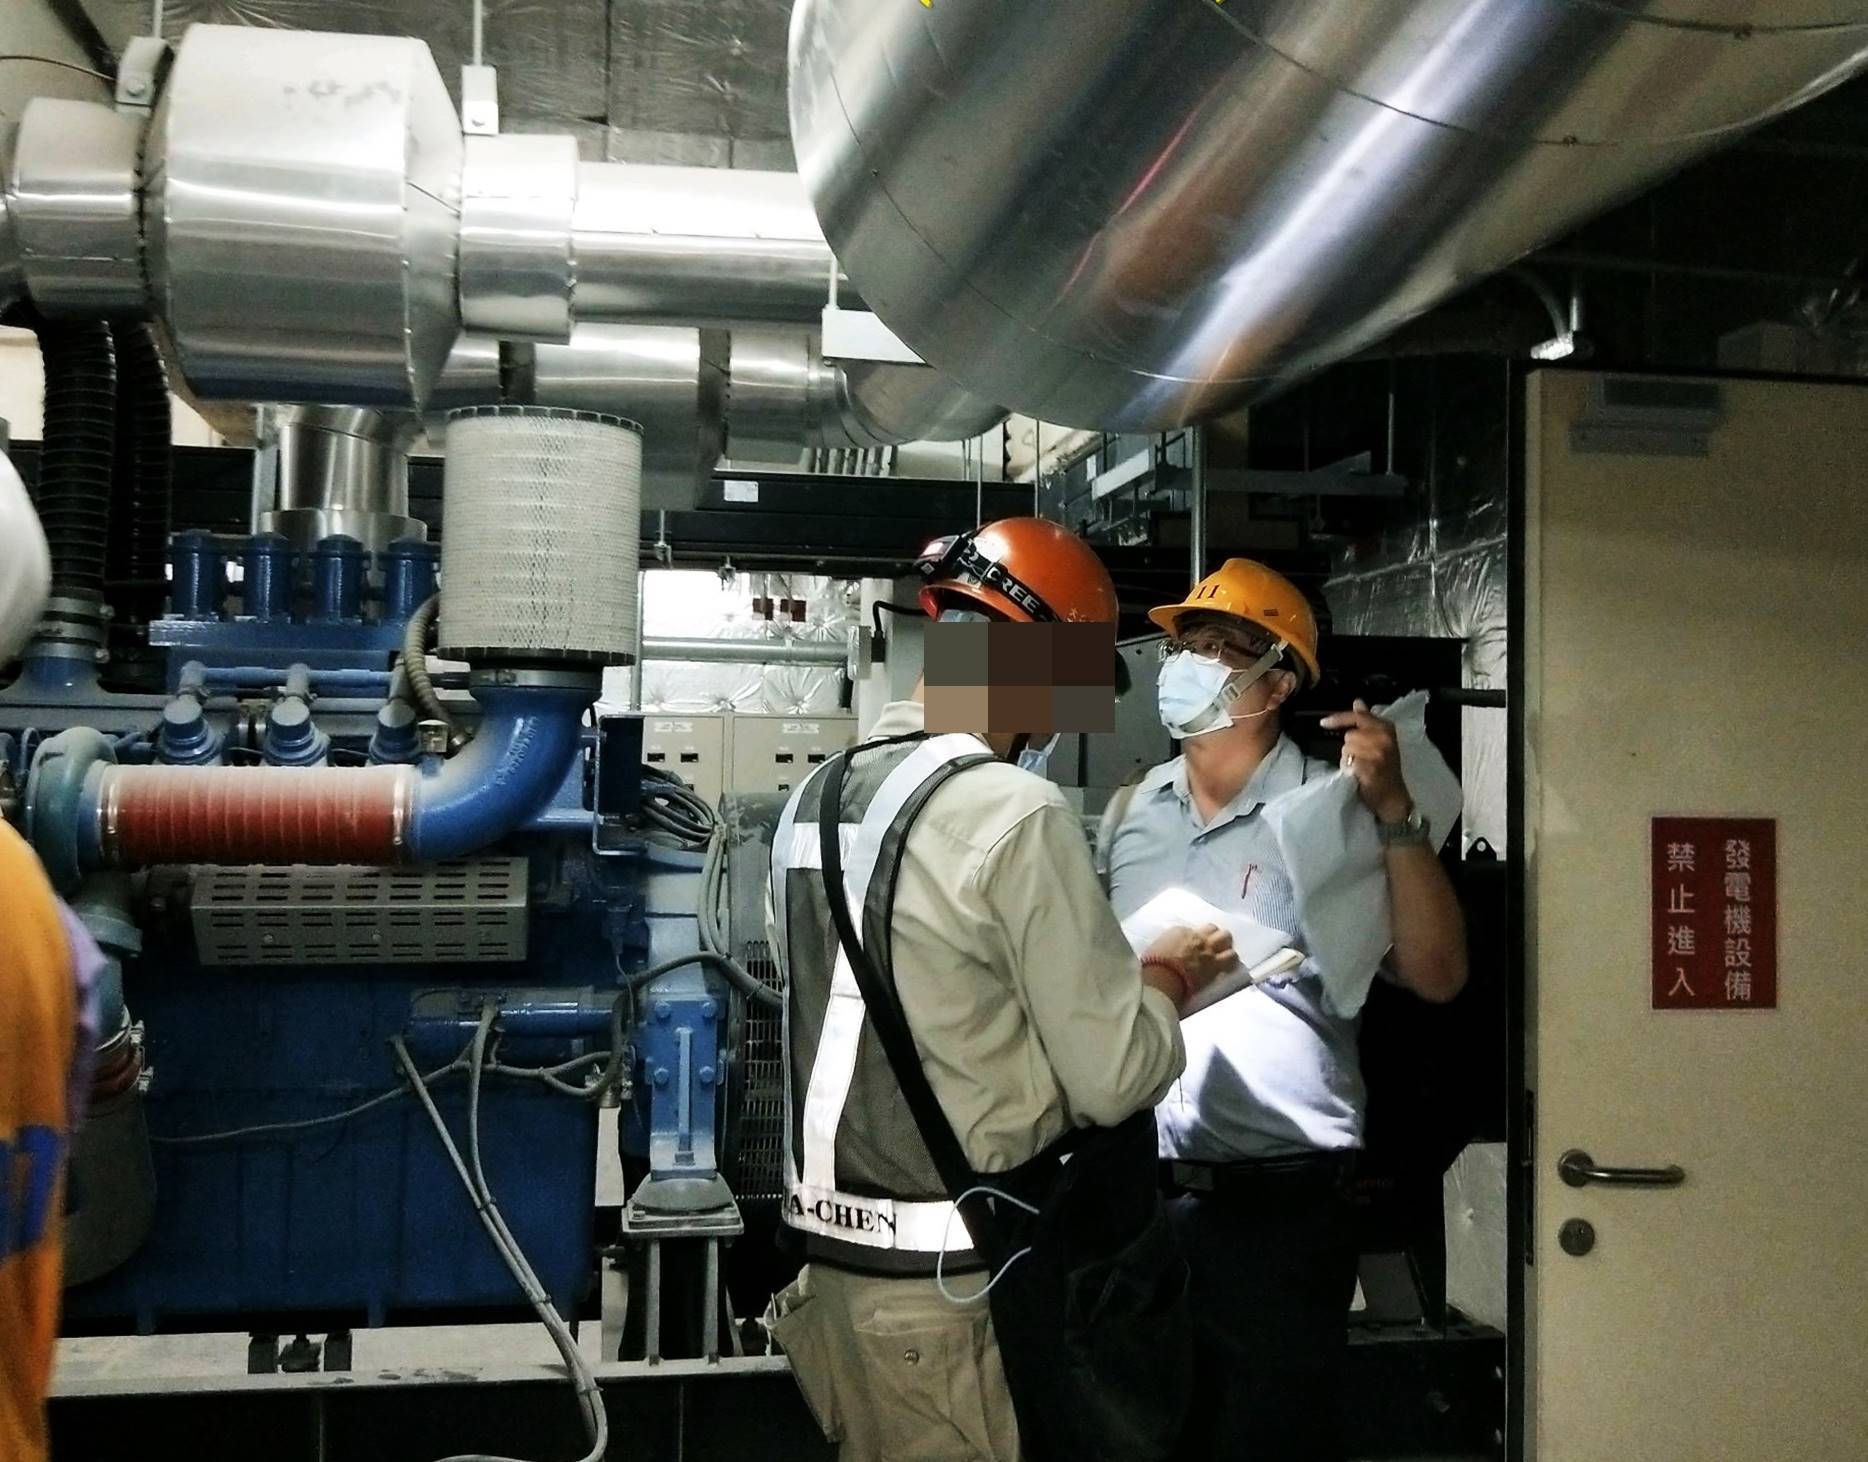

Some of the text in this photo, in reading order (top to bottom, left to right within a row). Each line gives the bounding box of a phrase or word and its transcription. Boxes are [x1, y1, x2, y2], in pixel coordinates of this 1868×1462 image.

[986, 565, 1040, 614] CREE
[1667, 842, 1696, 996] 禁止進入
[1724, 839, 1752, 1001] 發電機設備
